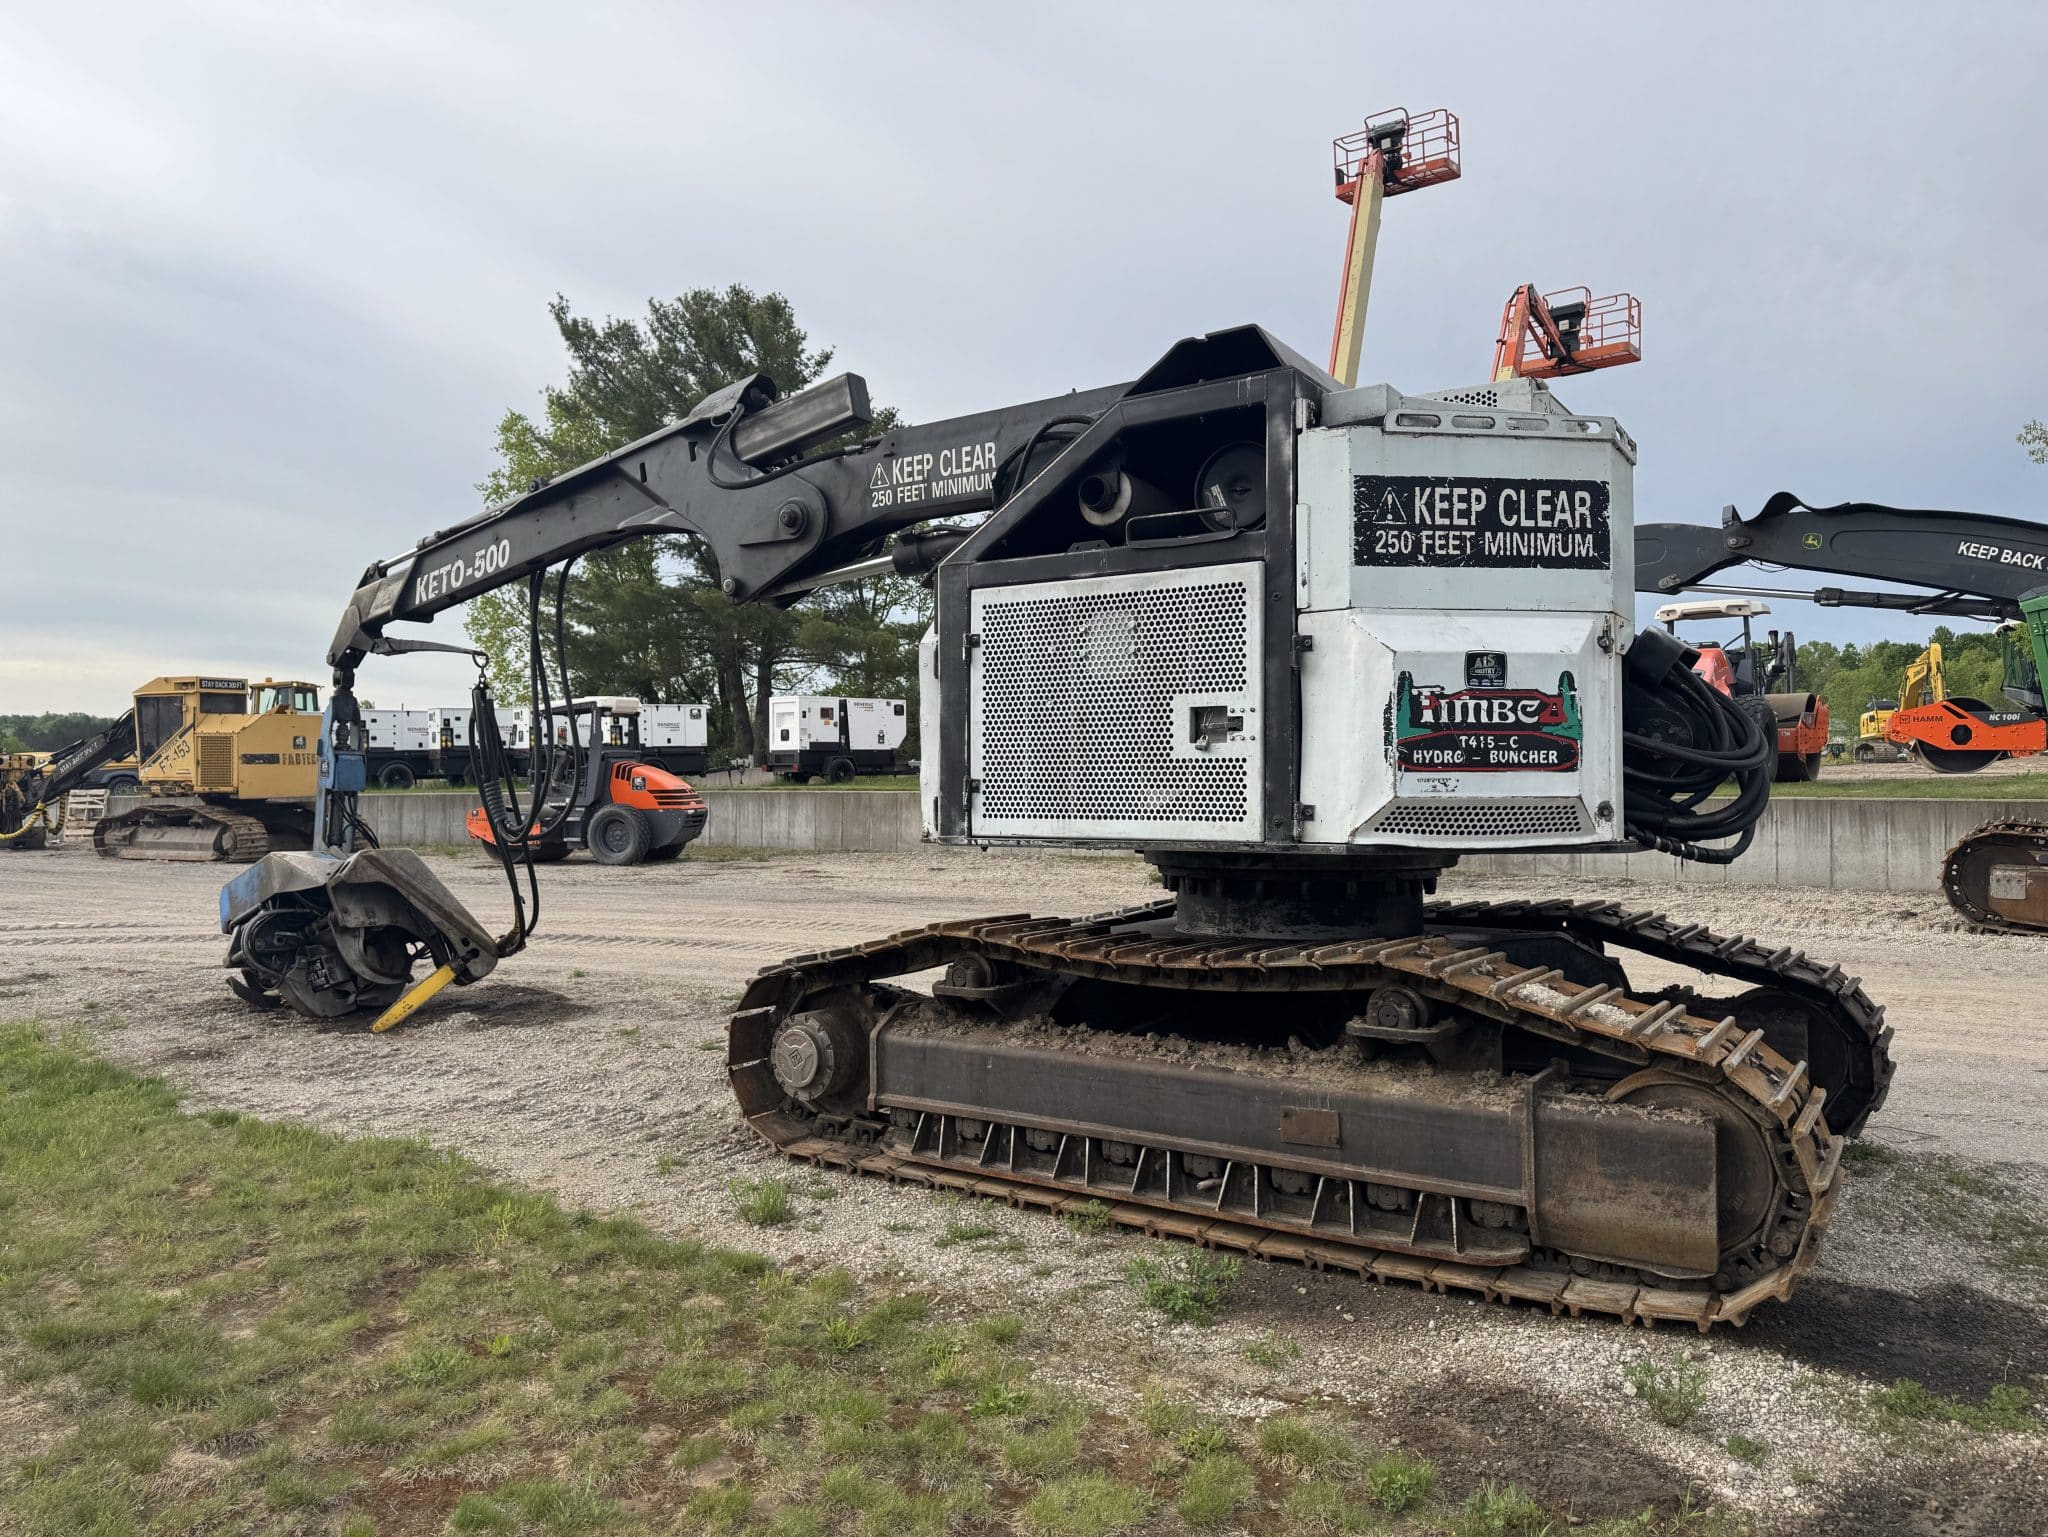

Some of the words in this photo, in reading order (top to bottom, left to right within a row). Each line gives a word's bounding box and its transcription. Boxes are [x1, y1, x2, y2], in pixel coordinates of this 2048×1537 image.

[892, 453, 933, 485] KEEP
[939, 442, 997, 477] CLEAR
[871, 489, 893, 508] 250
[897, 483, 928, 504] FEET
[932, 471, 997, 498] MINIMUM
[1414, 486, 1487, 526] KEEP
[1498, 488, 1592, 528] CLEAR
[1375, 530, 1413, 554] 250
[1421, 530, 1476, 555] FEET
[1485, 531, 1594, 558] MINIMUM
[1957, 541, 1999, 560] KEEP
[2000, 549, 2046, 570] BACK
[415, 538, 510, 605] KETO-500
[201, 680, 214, 688] STAY
[215, 681, 229, 689] BACK
[1912, 715, 1944, 723] HAMM
[1989, 713, 2001, 721] NC
[2002, 712, 2021, 721] 100i
[159, 740, 190, 775] FT-153
[1489, 750, 1559, 764] BUNCHER
